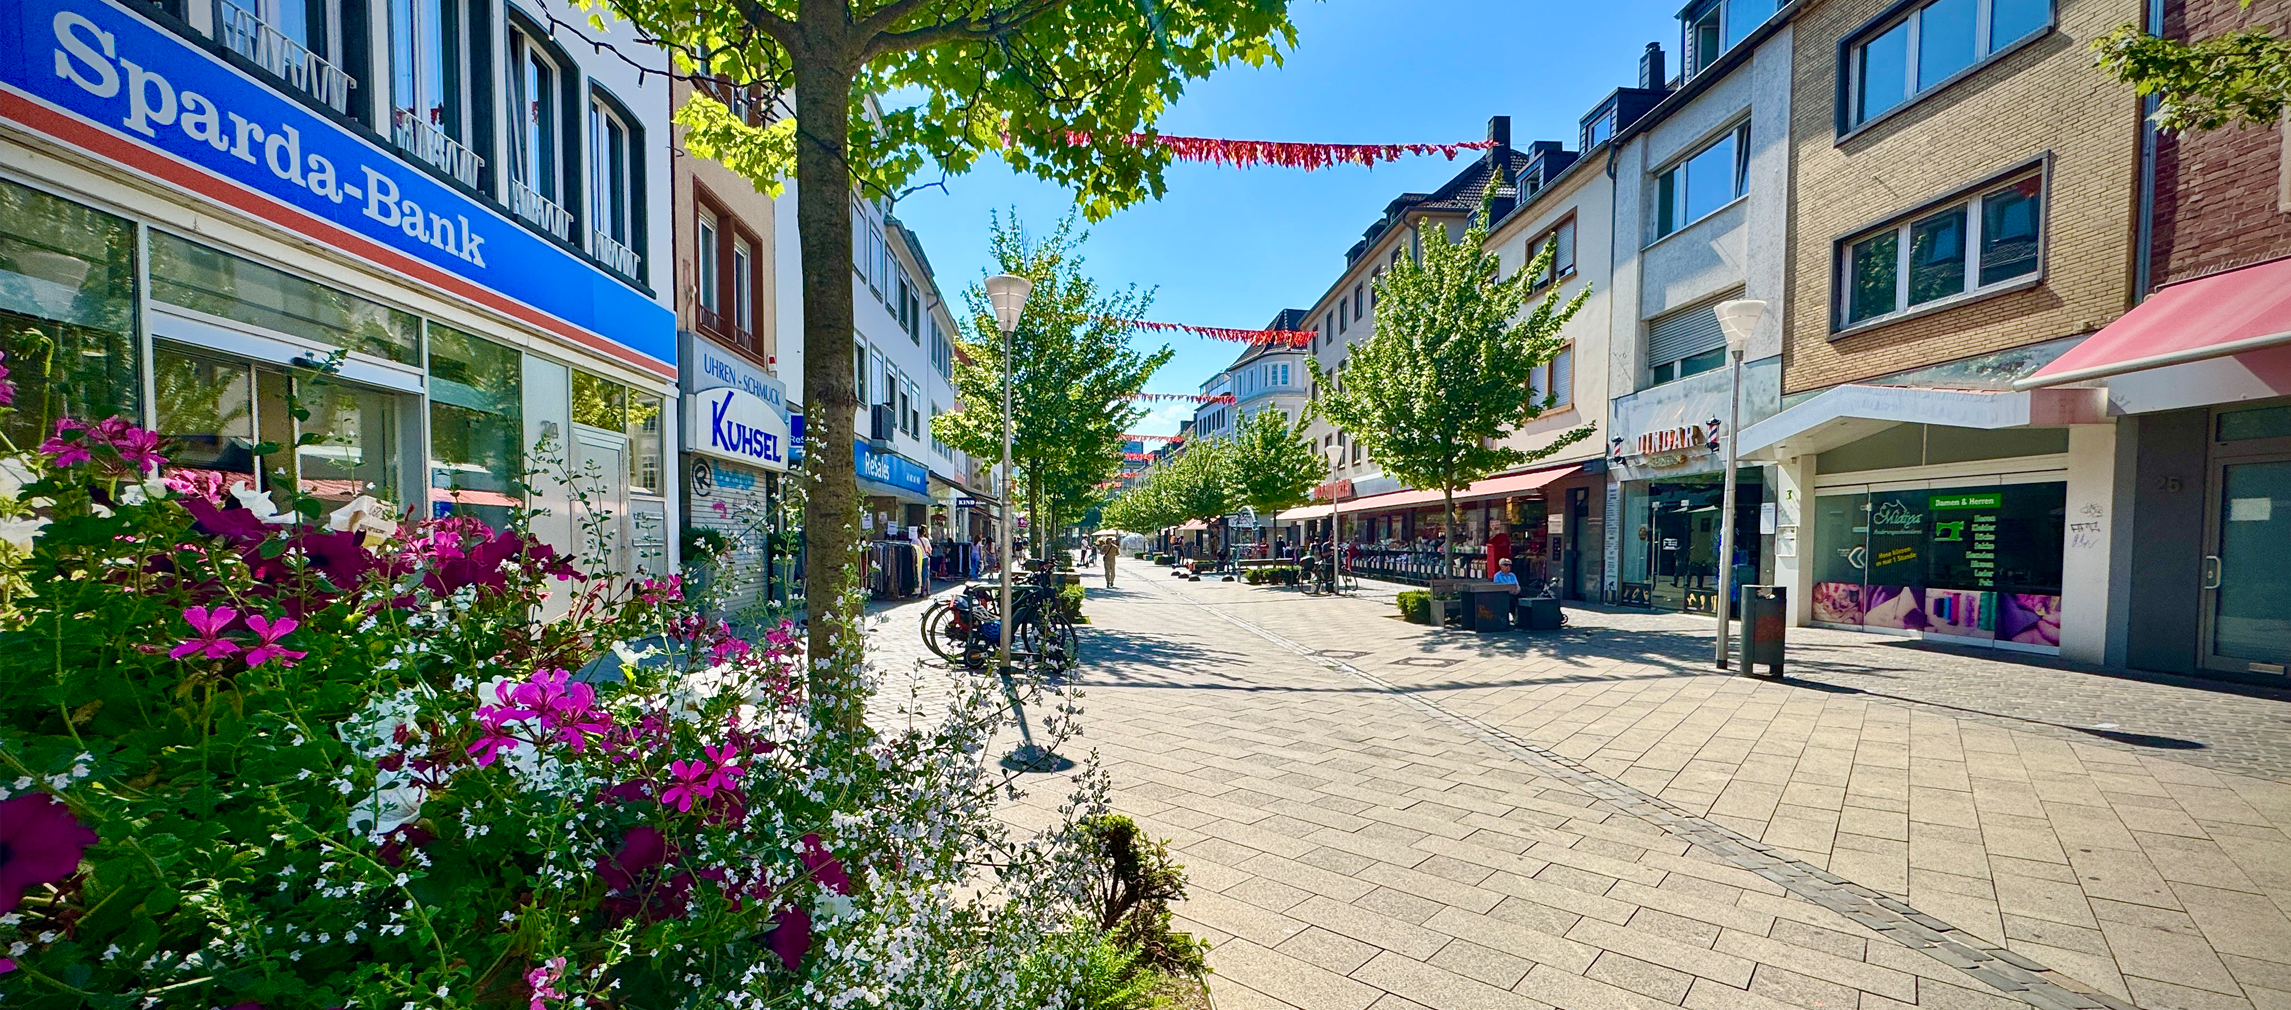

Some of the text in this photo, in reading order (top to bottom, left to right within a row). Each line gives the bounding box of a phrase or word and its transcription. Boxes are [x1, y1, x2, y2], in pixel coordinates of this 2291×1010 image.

[53, 11, 486, 269] Sparda-Bank
[704, 353, 736, 386] UHREN
[743, 374, 780, 406] SCHMUCK
[711, 390, 782, 463] KUHSEL
[865, 451, 890, 481] ReSales
[2155, 475, 2181, 493] 25
[1786, 489, 1793, 500] 3
[1935, 497, 1995, 507] Damen & Herren
[1971, 523, 1996, 532] Kleider
[1965, 550, 1995, 559] Hemden
[1974, 569, 1995, 577] Leder
